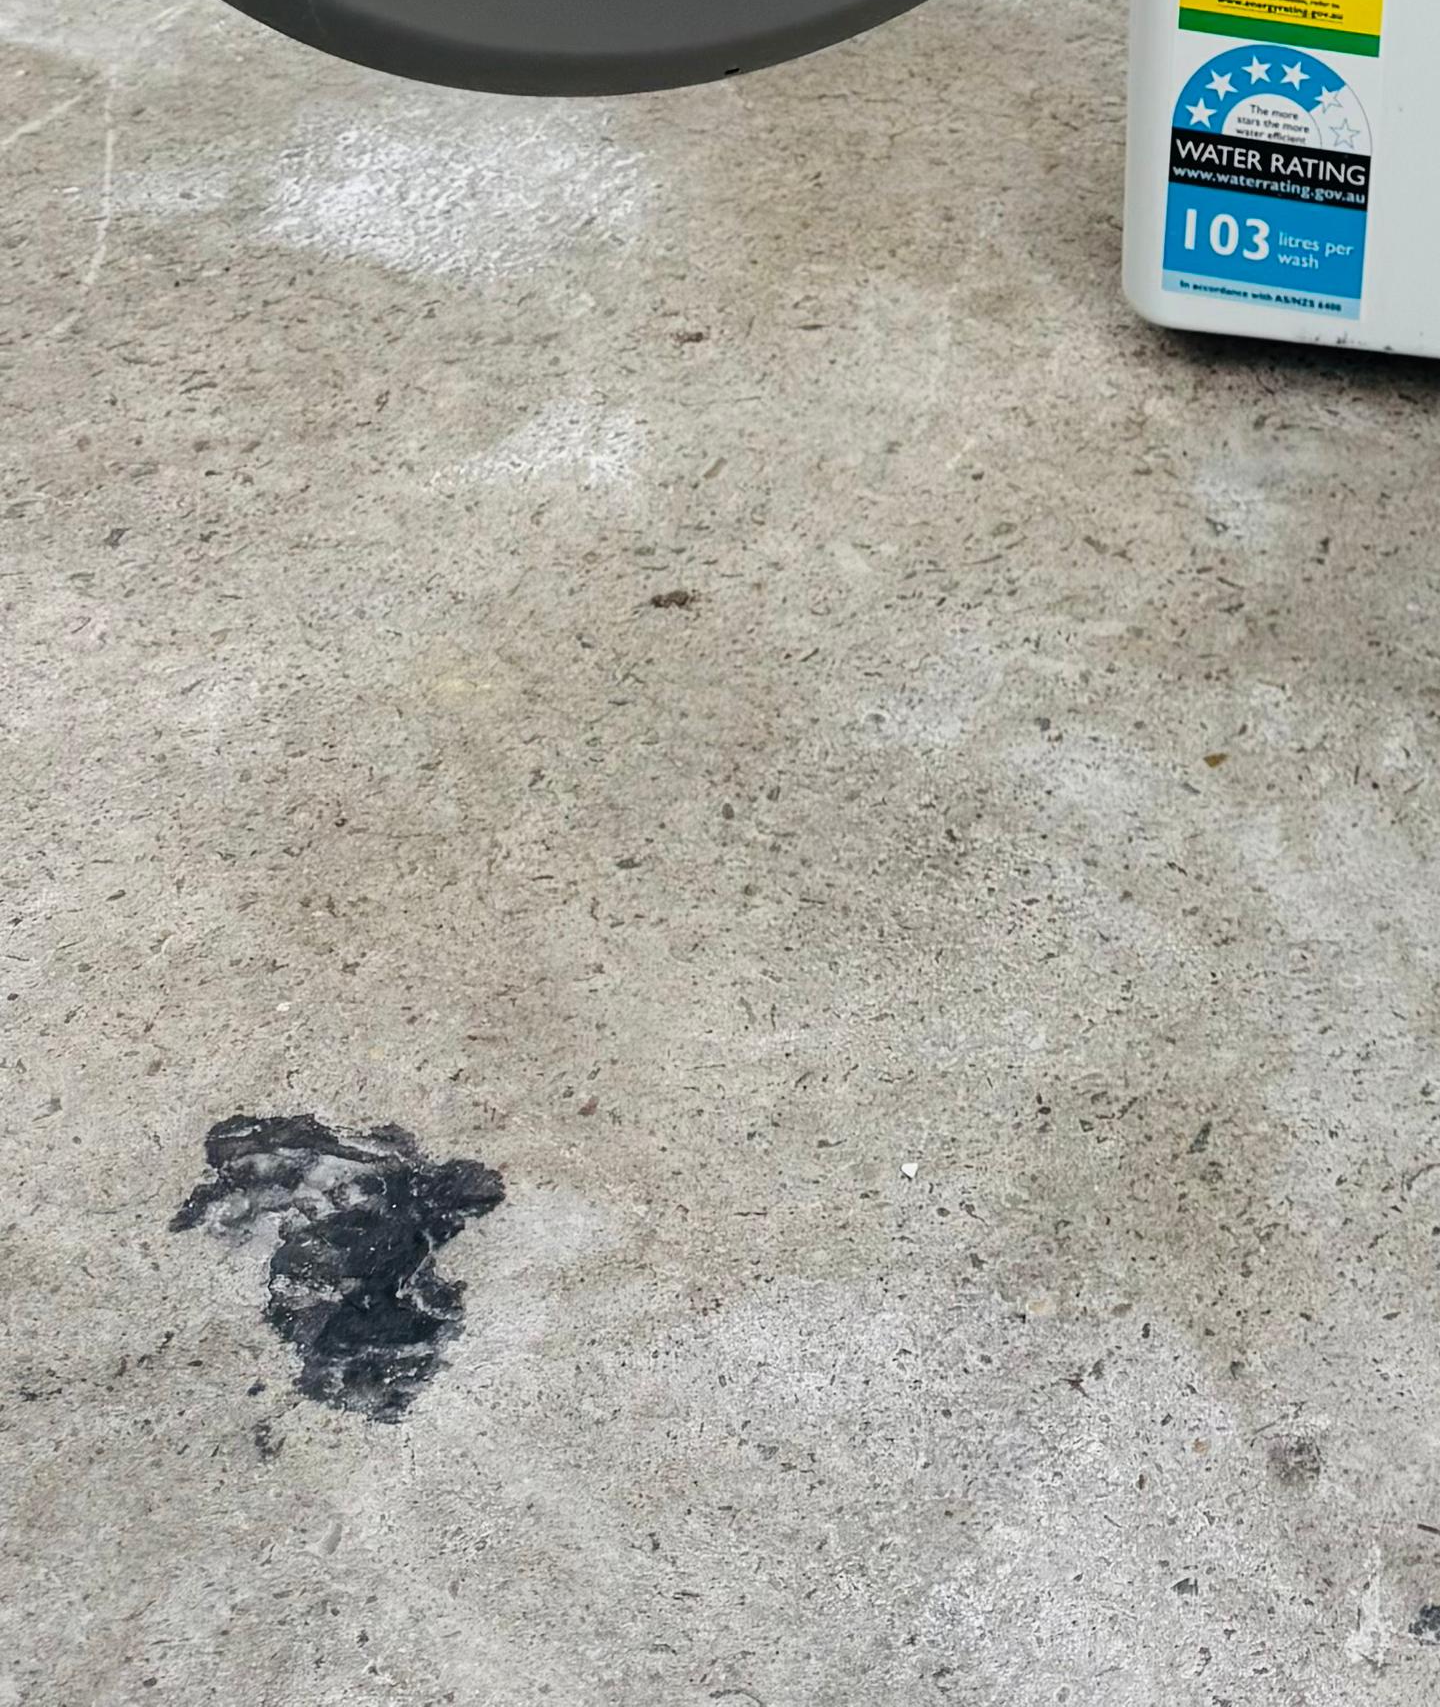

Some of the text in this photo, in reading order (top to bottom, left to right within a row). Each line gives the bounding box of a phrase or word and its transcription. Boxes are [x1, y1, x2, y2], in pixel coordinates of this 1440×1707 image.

[1250, 104, 1298, 120] The more
[1235, 128, 1306, 144] water efficient
[1236, 116, 1310, 133] stars the more
[1175, 138, 1367, 187] WATER RATING
[1172, 165, 1367, 205] www.waterrating.gov.au
[1184, 208, 1271, 261] 103
[1278, 230, 1355, 258] litres per
[1277, 252, 1319, 270] wash
[1179, 279, 1190, 288] In
[1193, 283, 1249, 298] accordance
[1251, 291, 1274, 302] with
